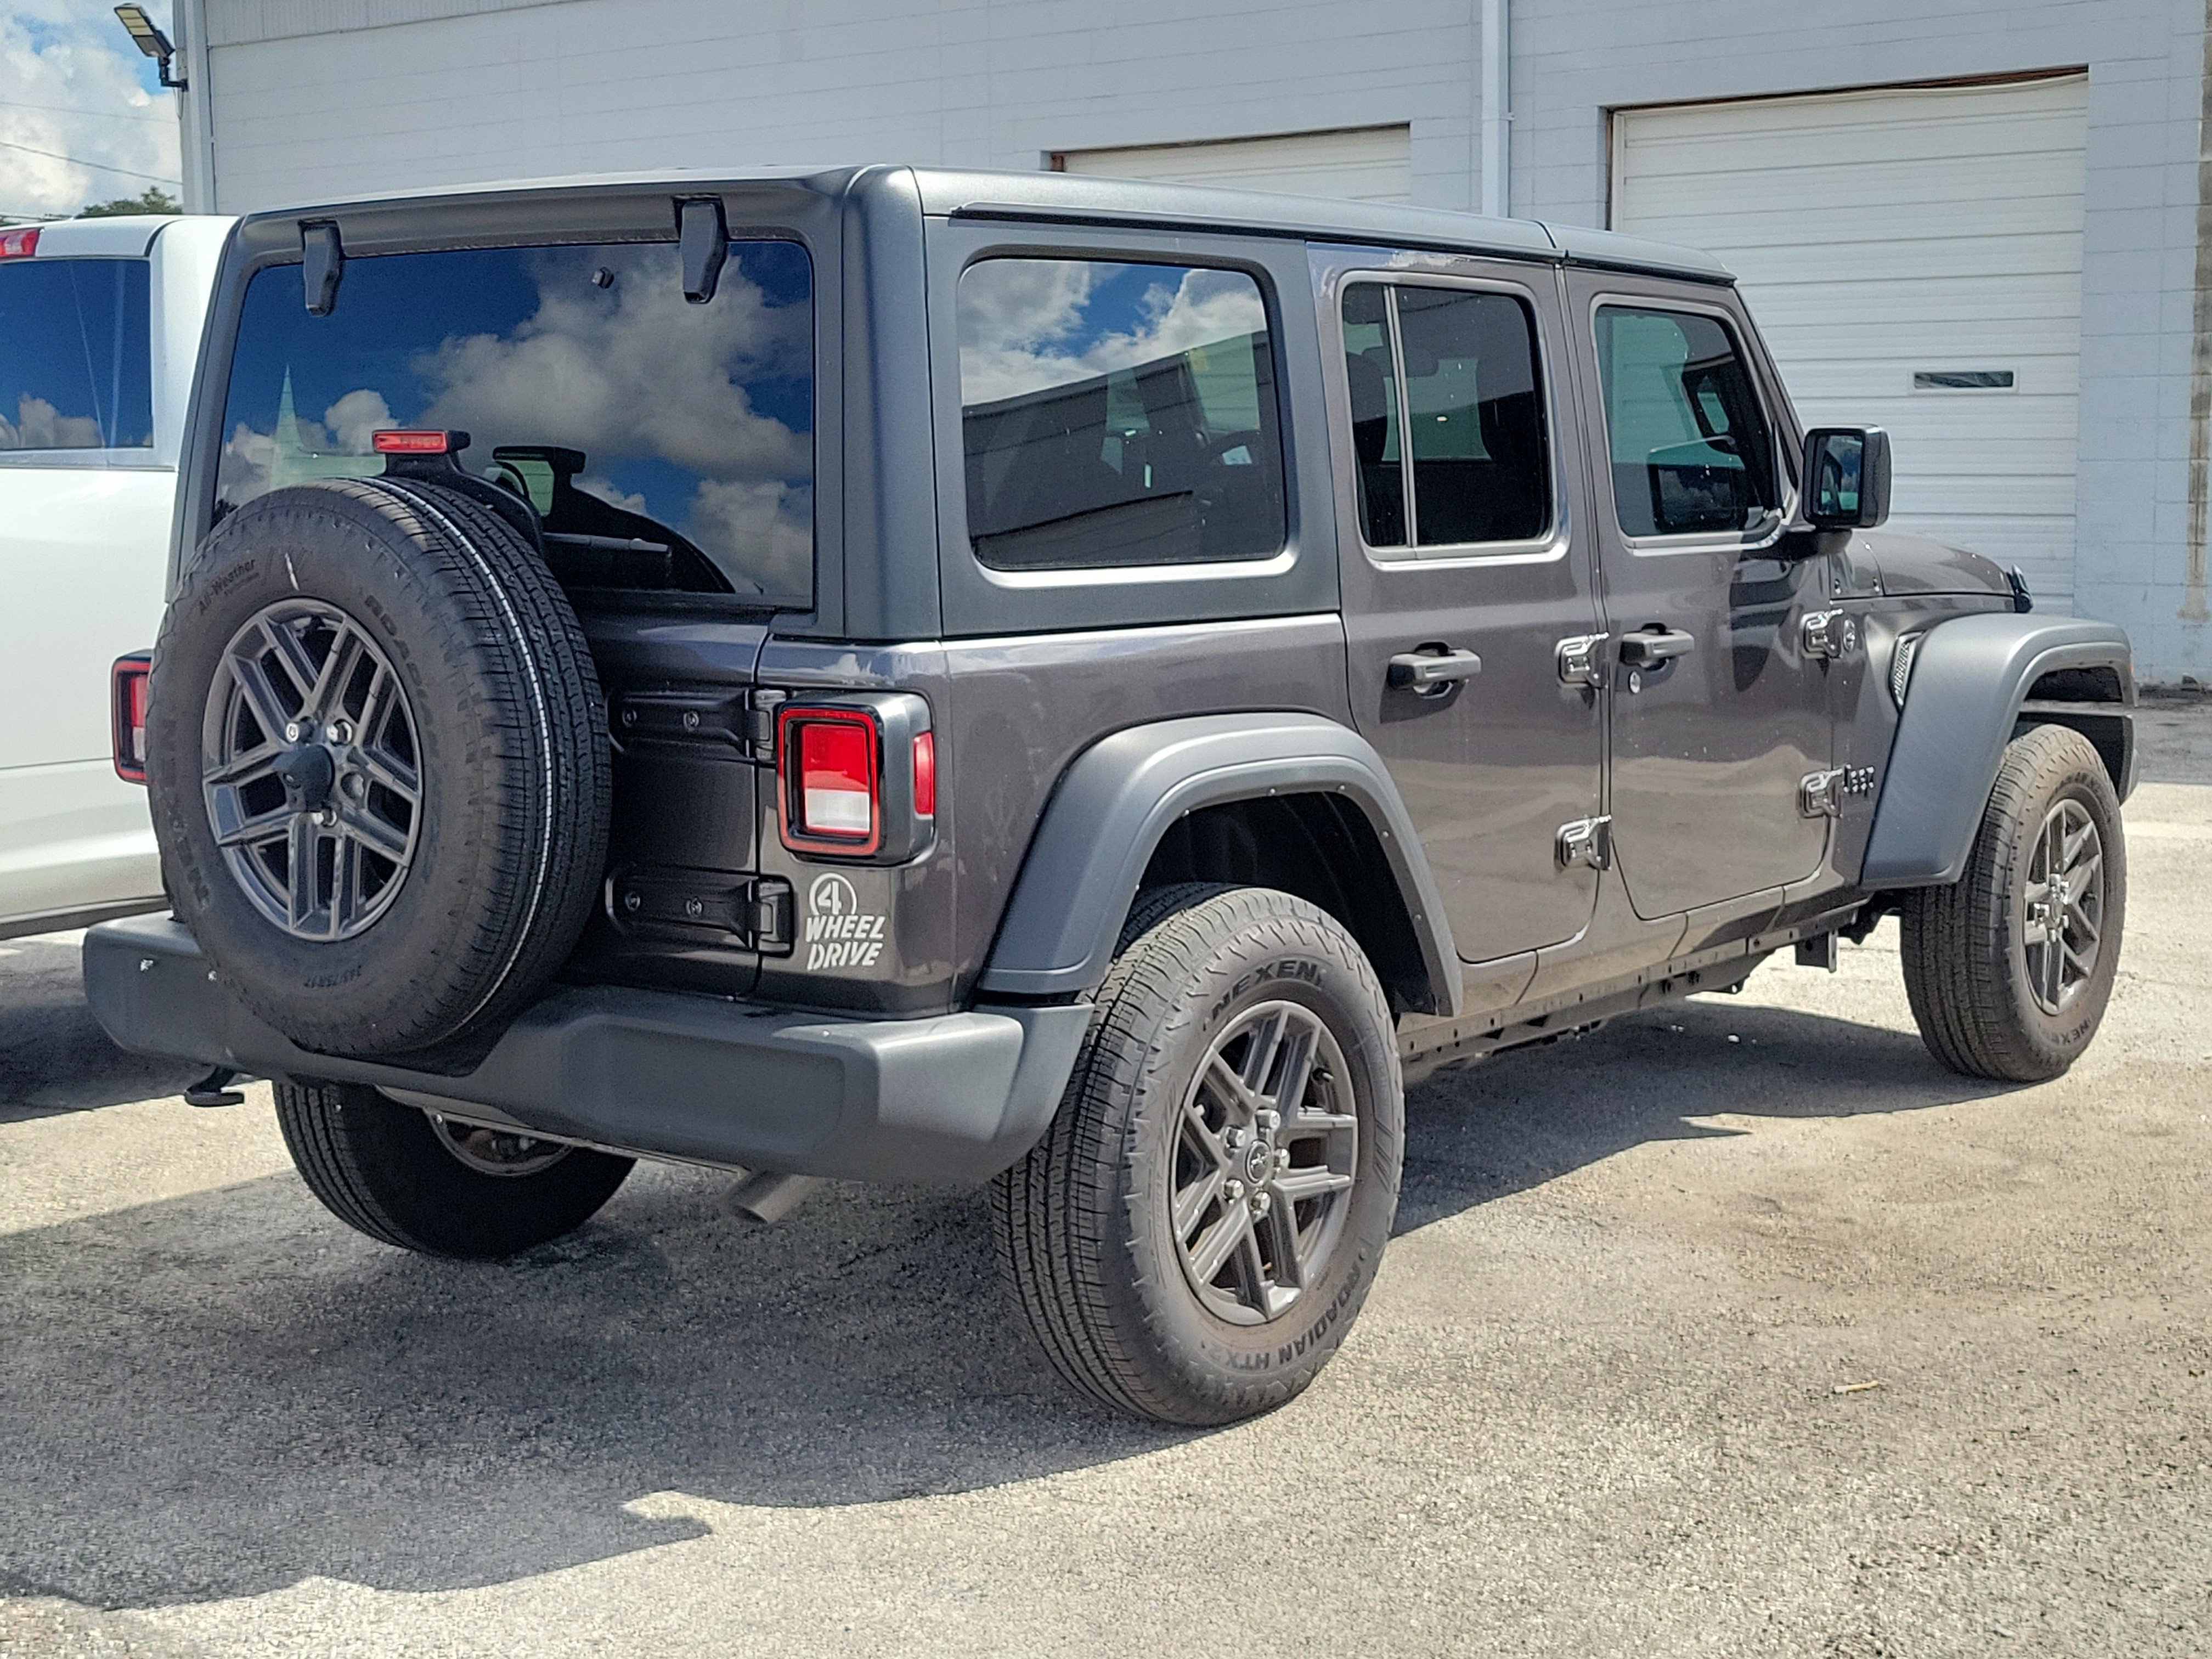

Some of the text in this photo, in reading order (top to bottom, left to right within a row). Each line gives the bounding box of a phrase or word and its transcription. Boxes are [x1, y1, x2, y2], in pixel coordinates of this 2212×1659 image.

[817, 881, 842, 915] 4
[805, 915, 885, 943] WHEEL
[807, 941, 883, 971] DRIVE
[1212, 960, 1318, 1021] NEXEN
[1278, 1261, 1362, 1365] ROADIAN
